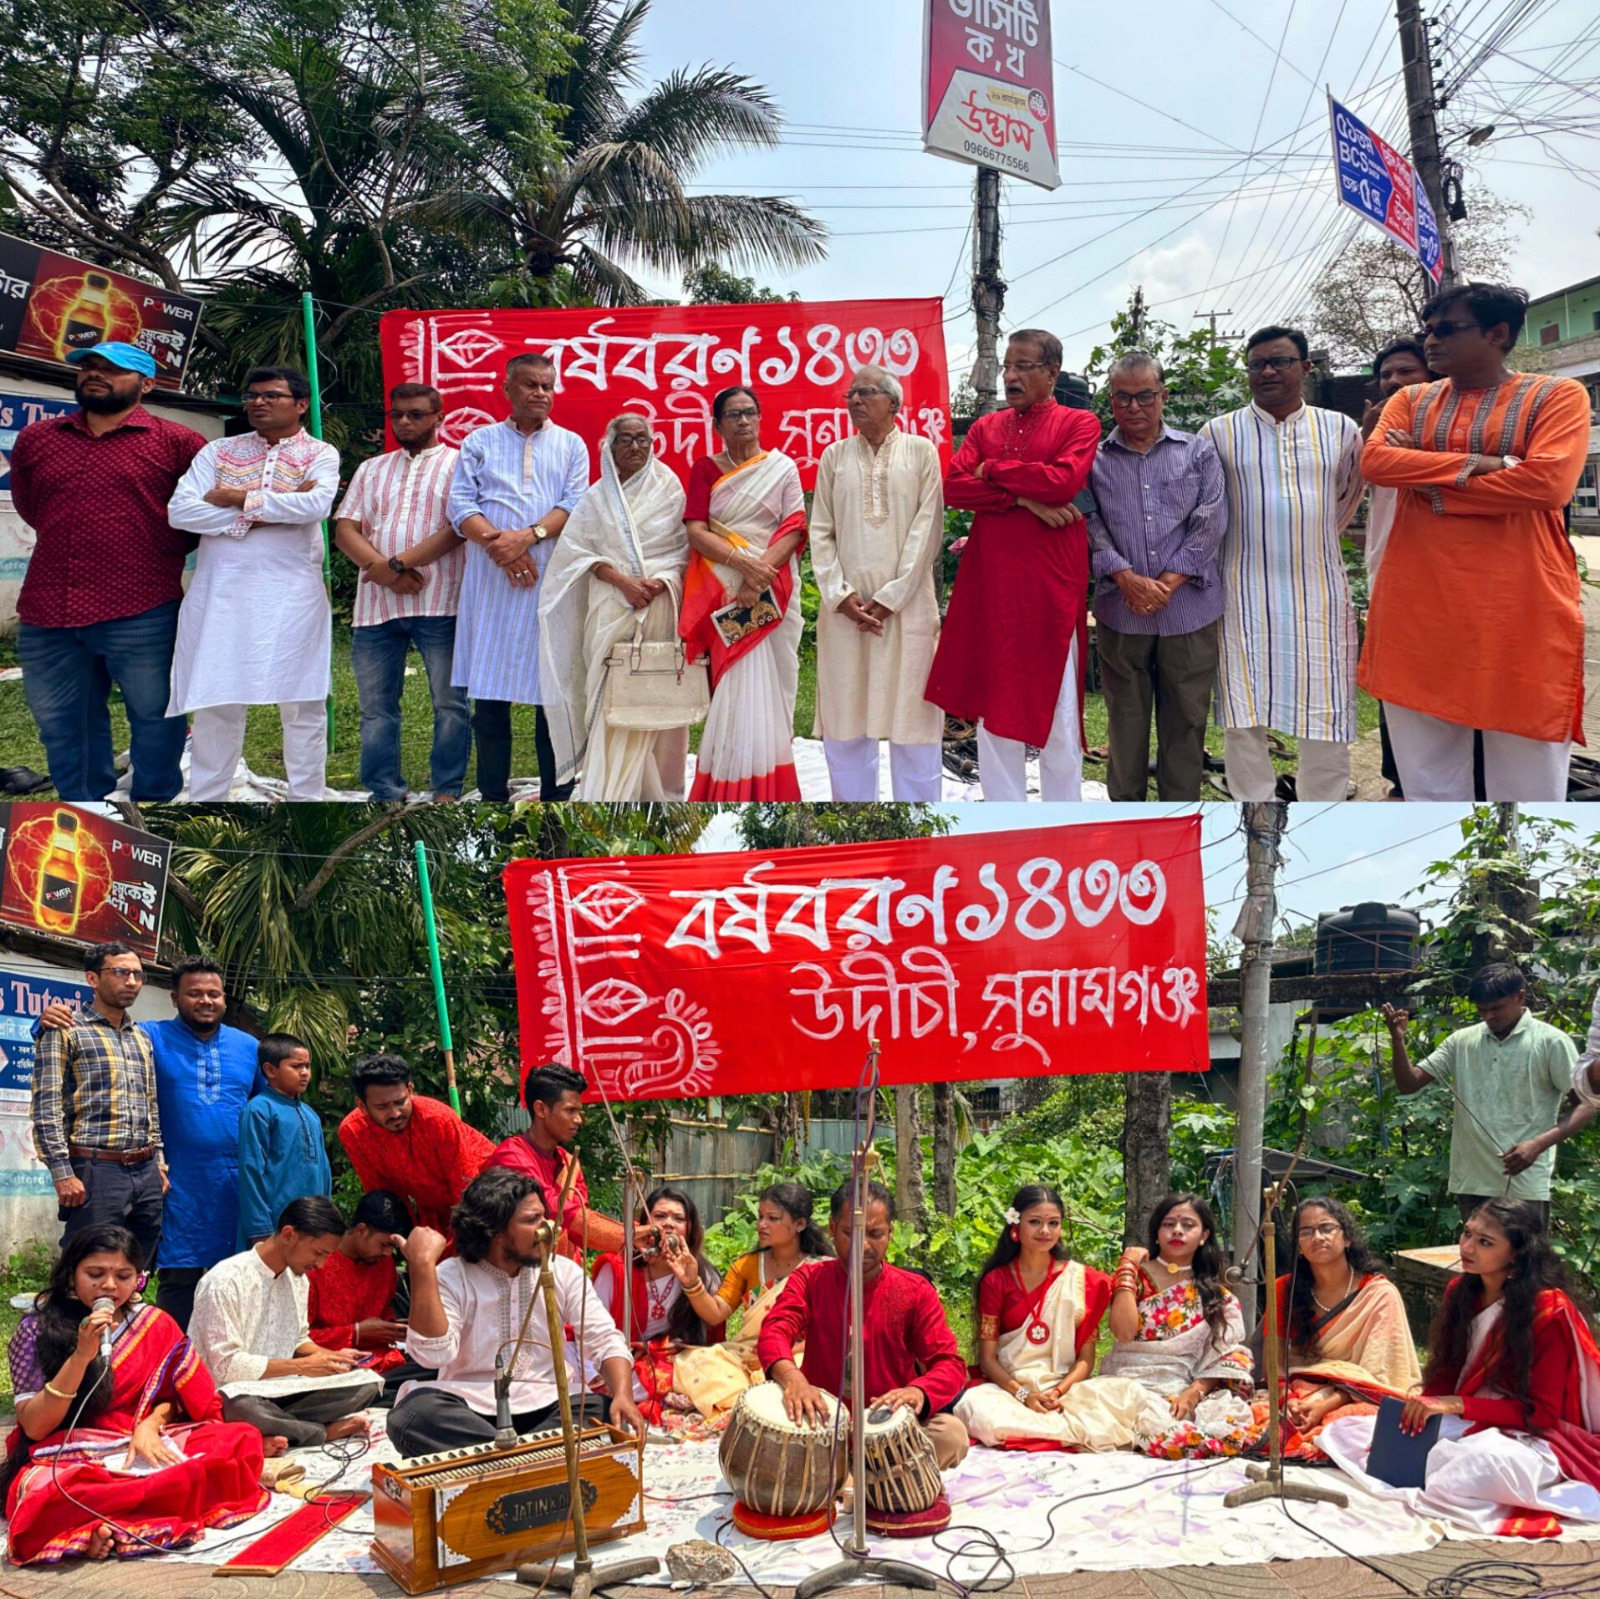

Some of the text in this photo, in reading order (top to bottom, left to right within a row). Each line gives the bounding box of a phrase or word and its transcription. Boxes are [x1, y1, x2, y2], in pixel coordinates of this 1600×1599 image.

[963, 140, 1030, 173] 09666775566
[1338, 140, 1369, 173] BCS
[143, 297, 193, 321] POWER
[68, 330, 97, 342] POWER
[133, 339, 183, 368] ACTION
[112, 840, 162, 869] POWER
[46, 887, 72, 901] POWER
[664, 856, 1167, 960] বর্ষবরণ ১৪৩৩
[106, 894, 156, 932] ACTION
[981, 964, 1200, 1068] সুনামগঞ্জ
